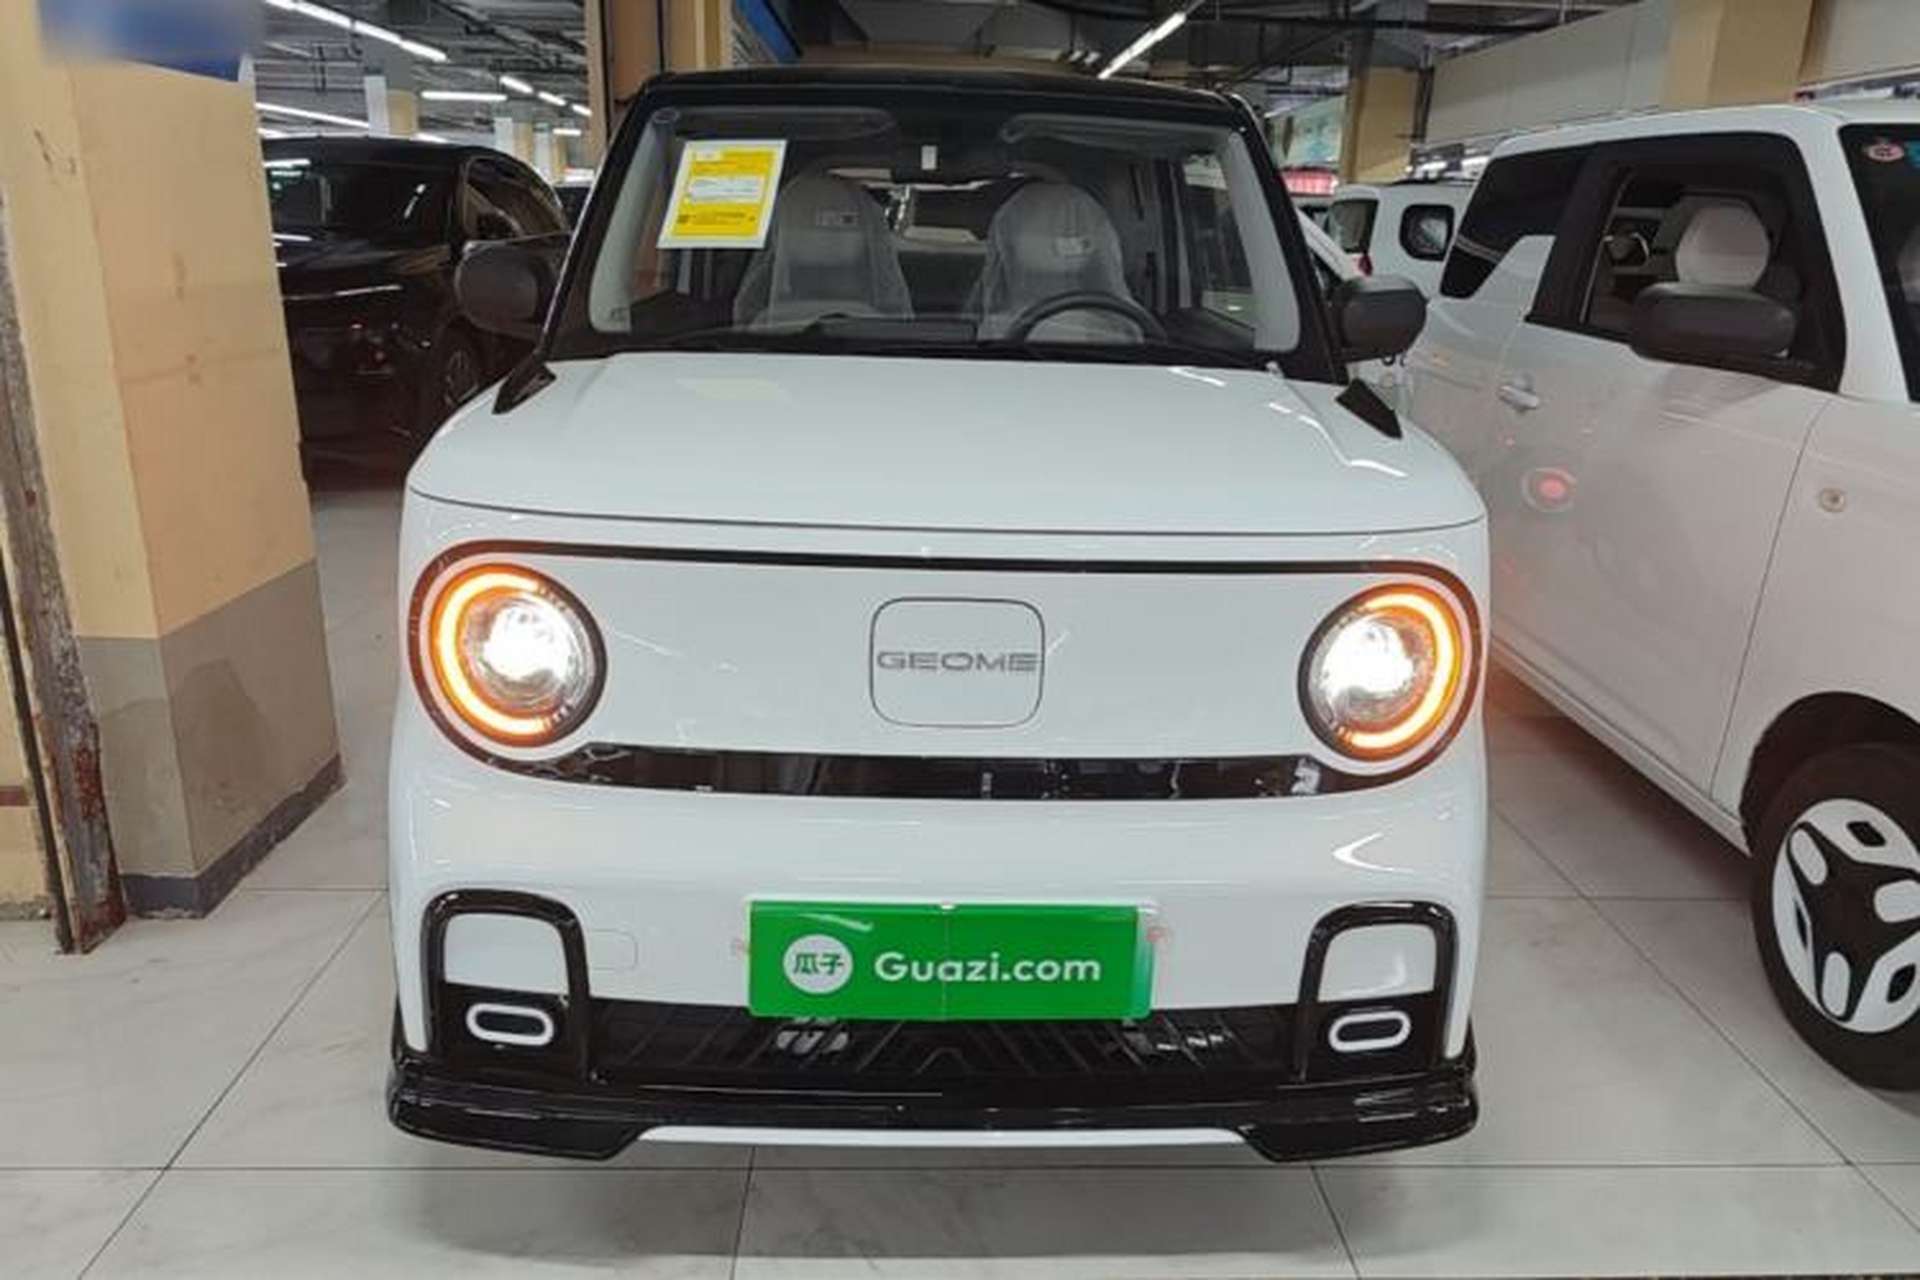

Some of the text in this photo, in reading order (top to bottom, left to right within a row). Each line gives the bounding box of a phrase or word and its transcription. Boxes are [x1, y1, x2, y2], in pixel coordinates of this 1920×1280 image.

[876, 651, 1039, 672] GEOME
[793, 951, 1102, 982] 瓜子 Guazi.com
